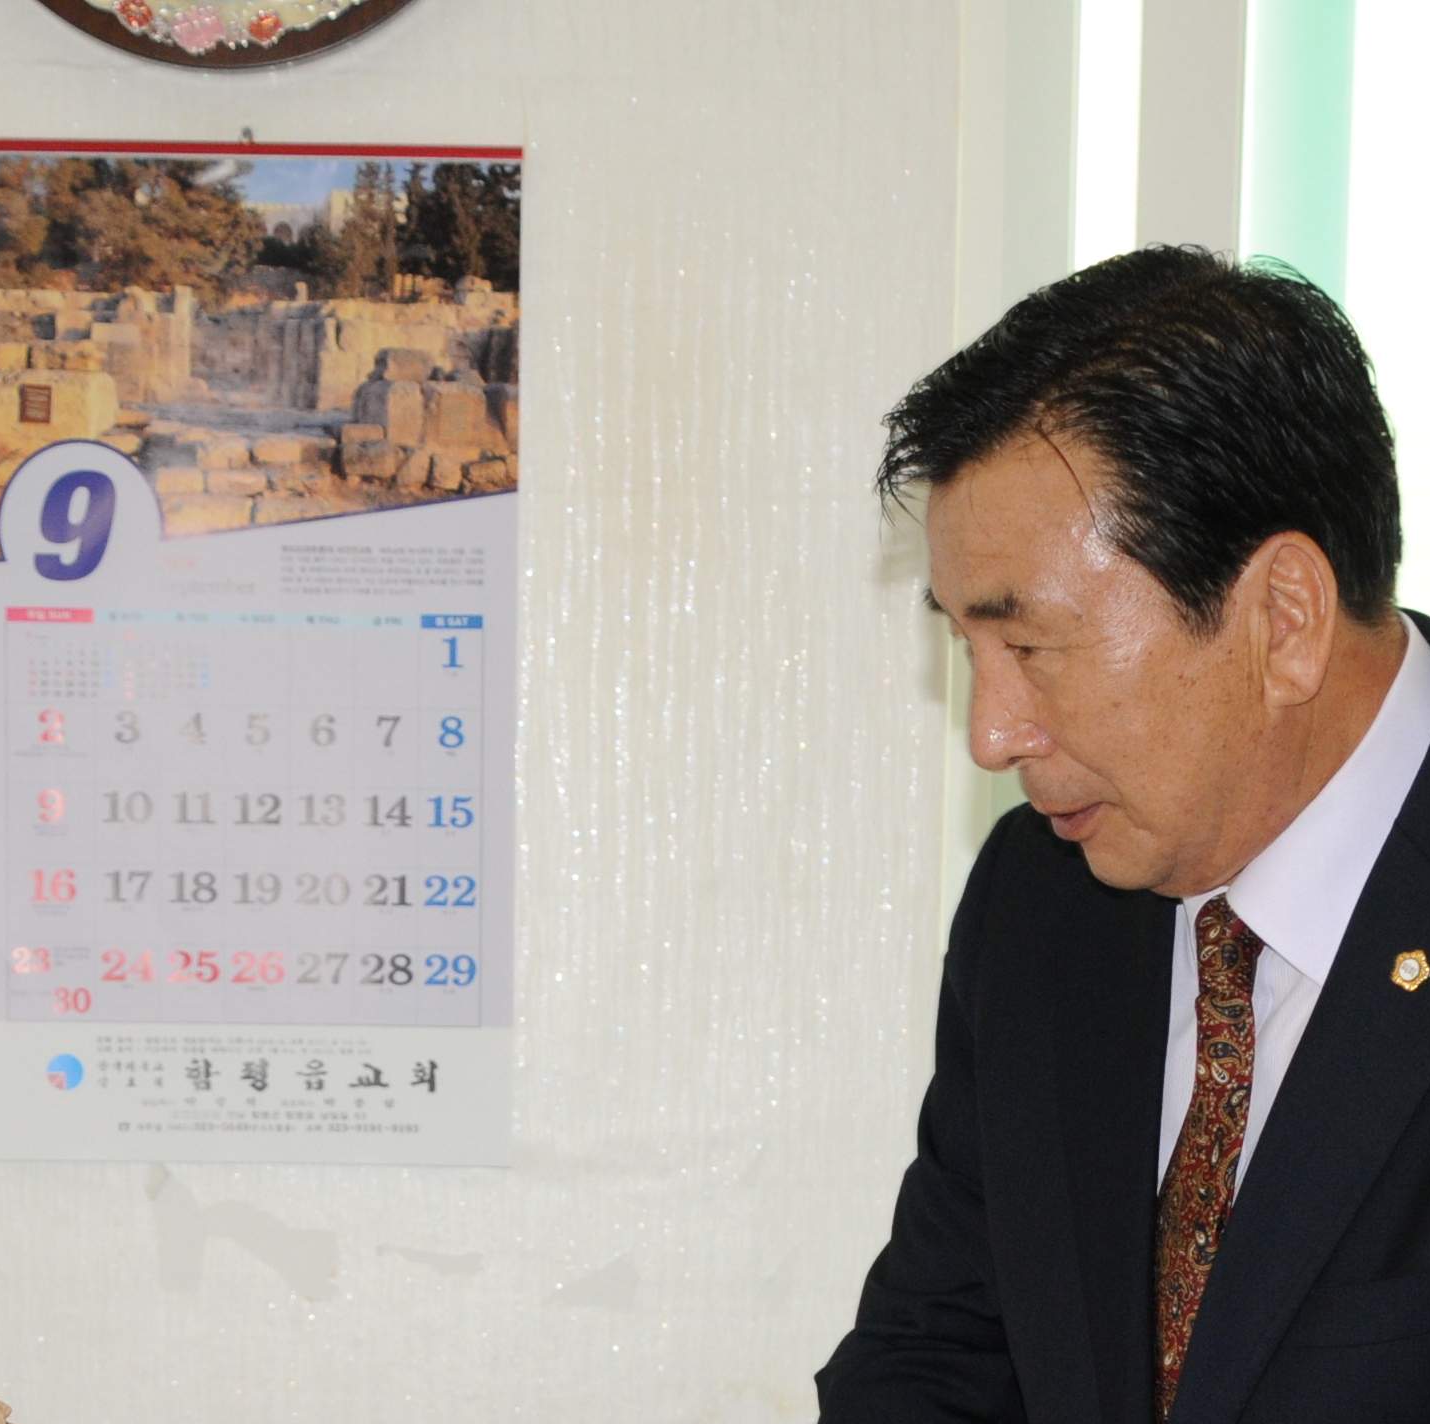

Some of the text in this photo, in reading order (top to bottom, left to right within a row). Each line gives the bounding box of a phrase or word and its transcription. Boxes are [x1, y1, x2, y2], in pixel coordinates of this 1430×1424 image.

[34, 469, 116, 582] 9
[441, 636, 464, 669] 1
[38, 709, 465, 749] 2 3 4 5 6 7 8
[38, 789, 474, 828] 9 10 11 12 13 14 15
[31, 869, 476, 907] 16 17 18 19 20 21 22
[12, 946, 51, 974] 23
[101, 949, 157, 983] 24
[167, 950, 221, 983] 25
[231, 951, 286, 984] 26
[297, 953, 349, 985] 27
[361, 953, 414, 987] 28
[425, 954, 477, 986] 29
[52, 987, 93, 1014] 30
